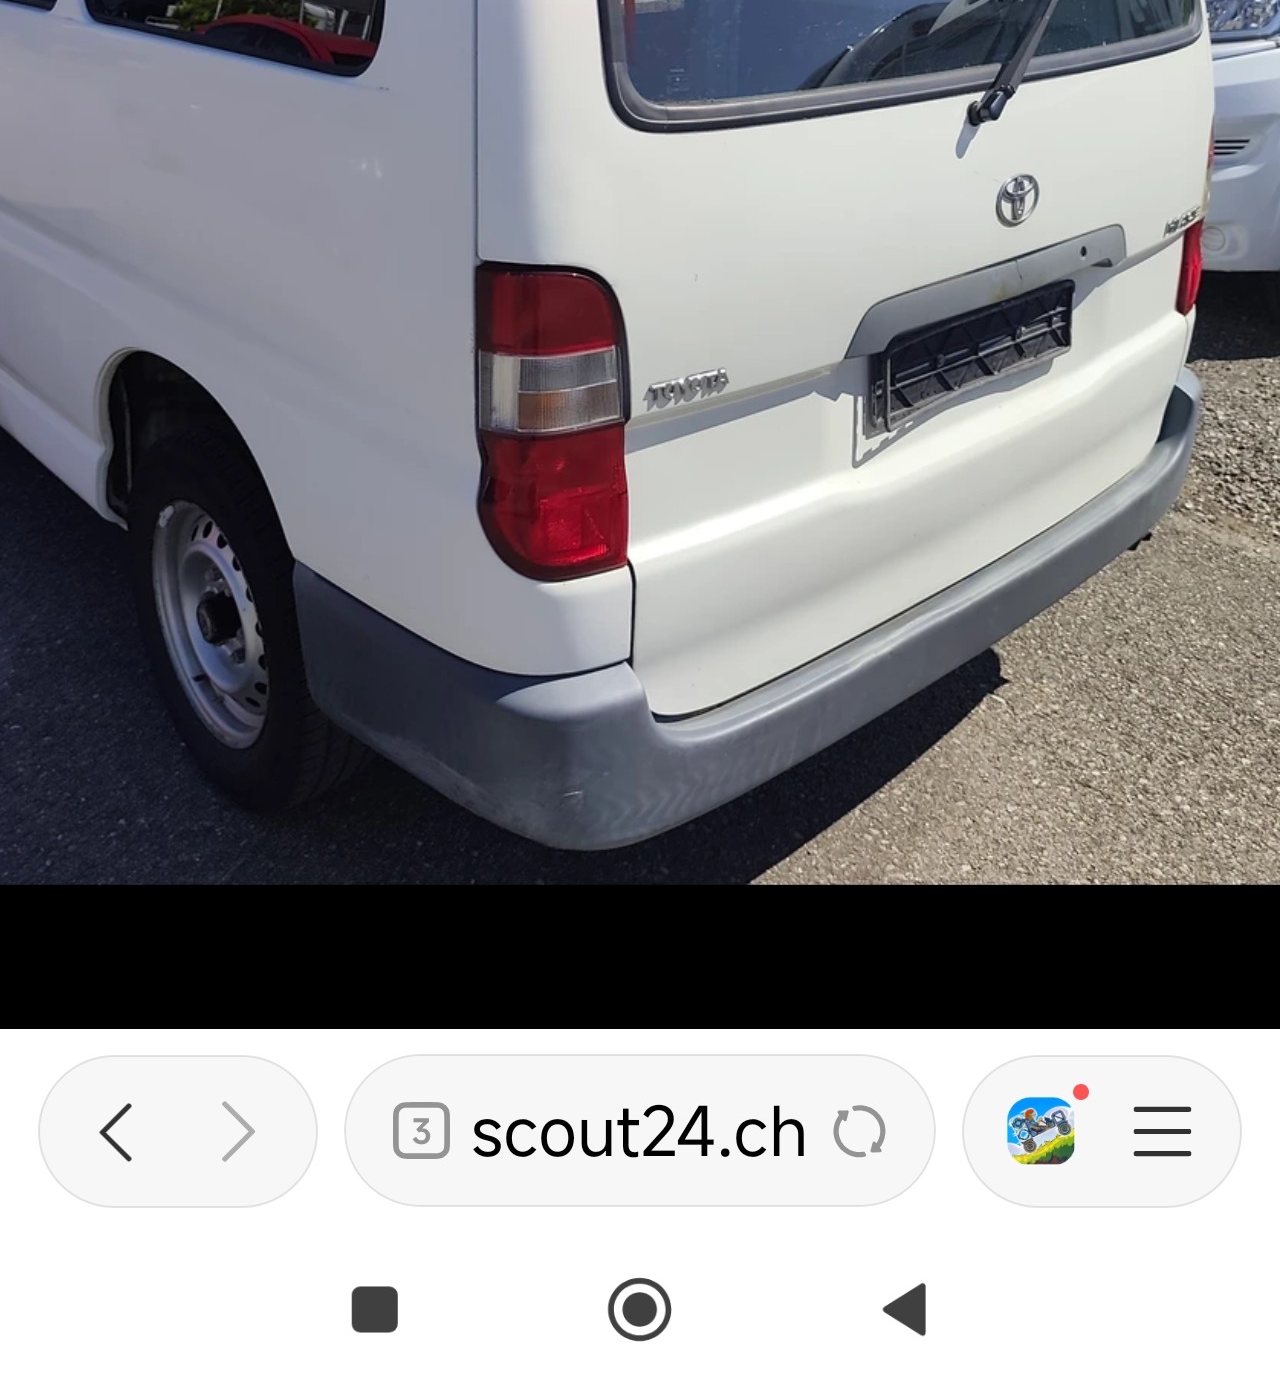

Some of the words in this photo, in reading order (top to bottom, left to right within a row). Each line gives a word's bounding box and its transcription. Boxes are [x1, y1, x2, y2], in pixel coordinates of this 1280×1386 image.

[644, 367, 729, 406] TOYOTA
[412, 1117, 431, 1145] 3
[472, 1104, 805, 1158] scout24.ch
